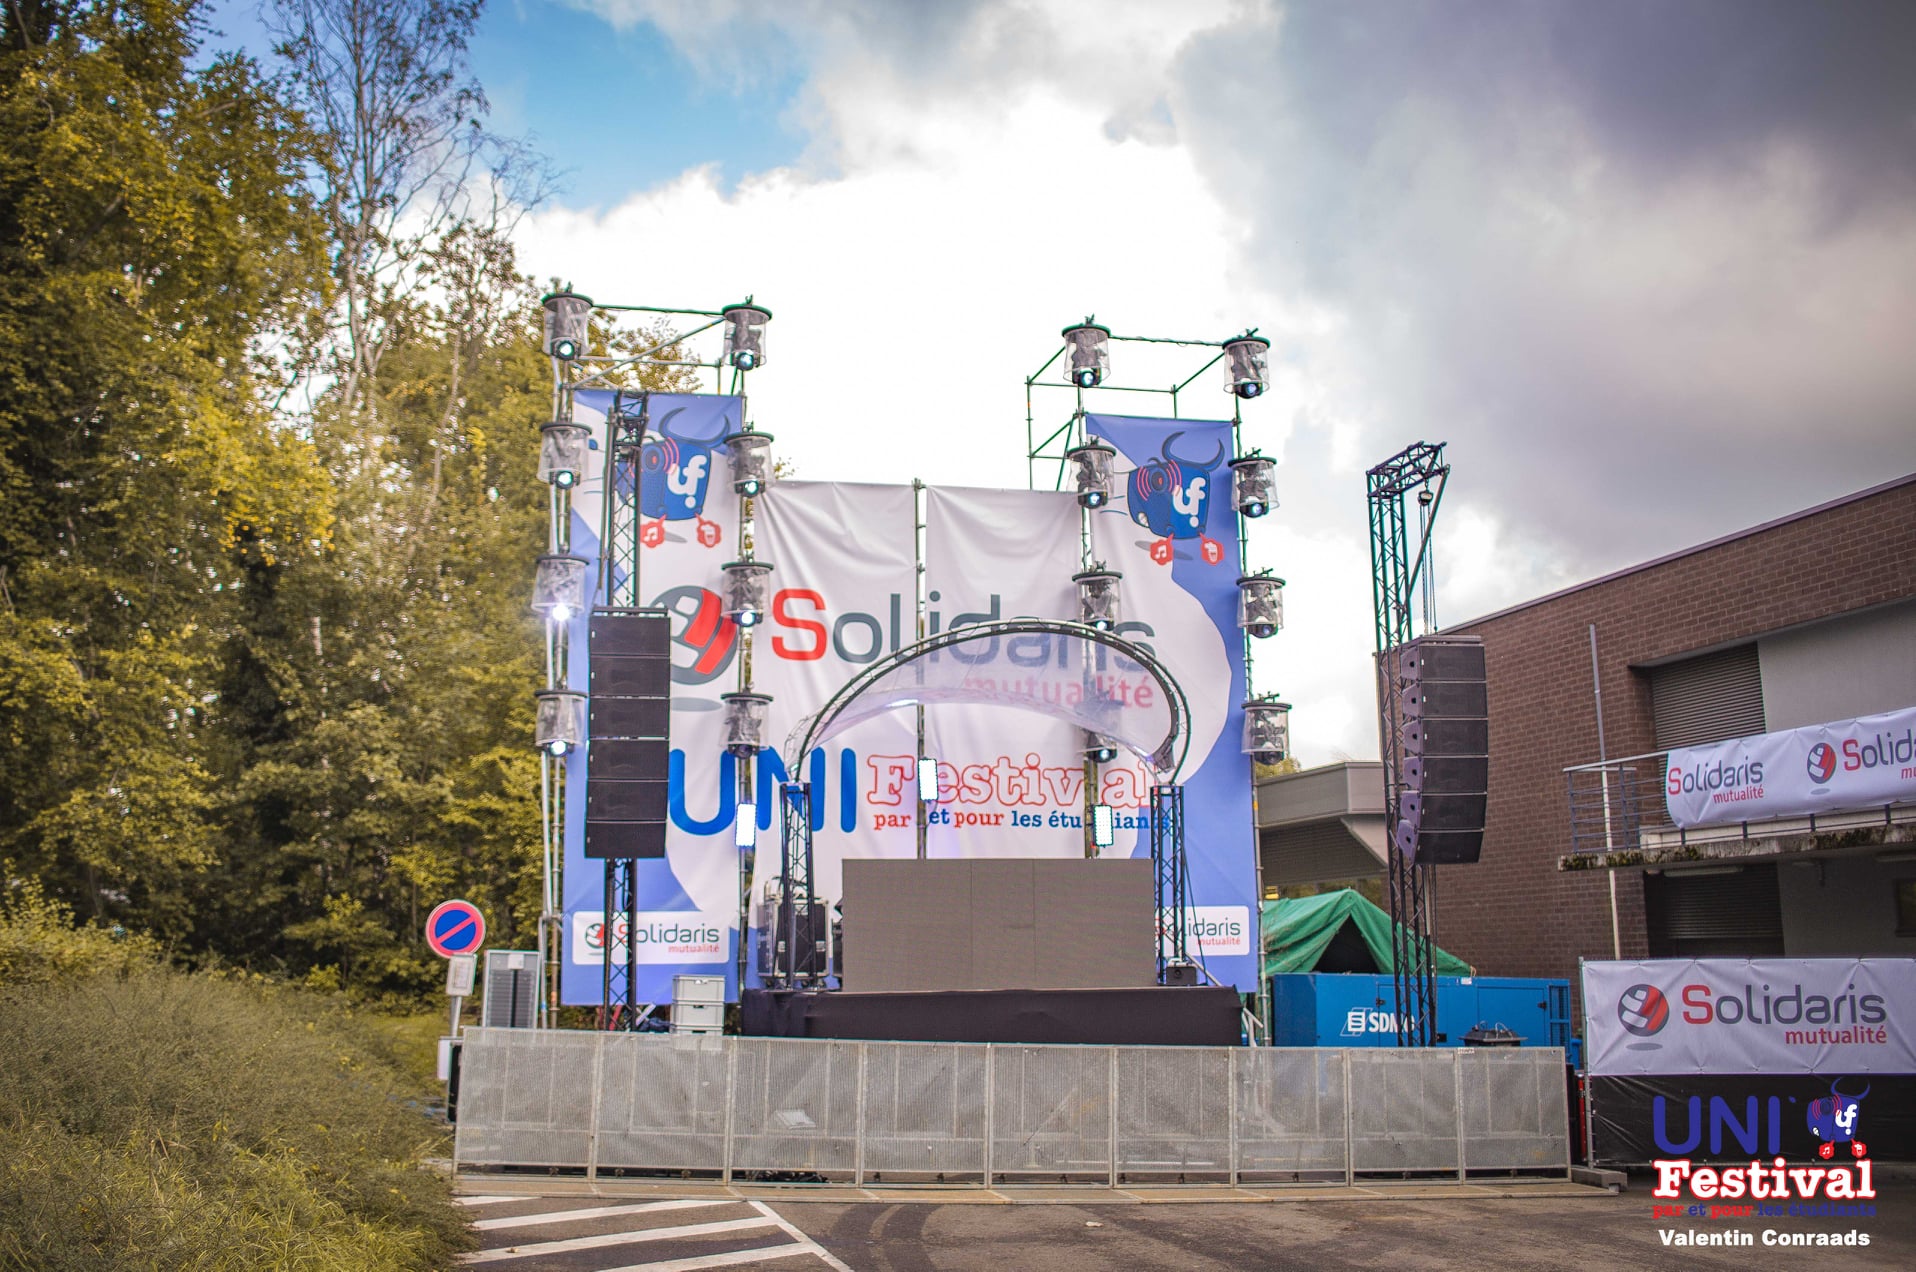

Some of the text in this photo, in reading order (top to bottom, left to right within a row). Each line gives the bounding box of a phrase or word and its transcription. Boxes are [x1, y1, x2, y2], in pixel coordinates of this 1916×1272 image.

[1842, 728, 1916, 772] Solid
[669, 745, 857, 836] UNI
[1667, 755, 1764, 796] Solidaris
[1712, 783, 1765, 805] mutualité
[873, 808, 1170, 830] par et pour les étuians
[668, 943, 720, 953] mutualité
[1681, 983, 1887, 1025] Solidaris
[1785, 1025, 1887, 1044] mutualité
